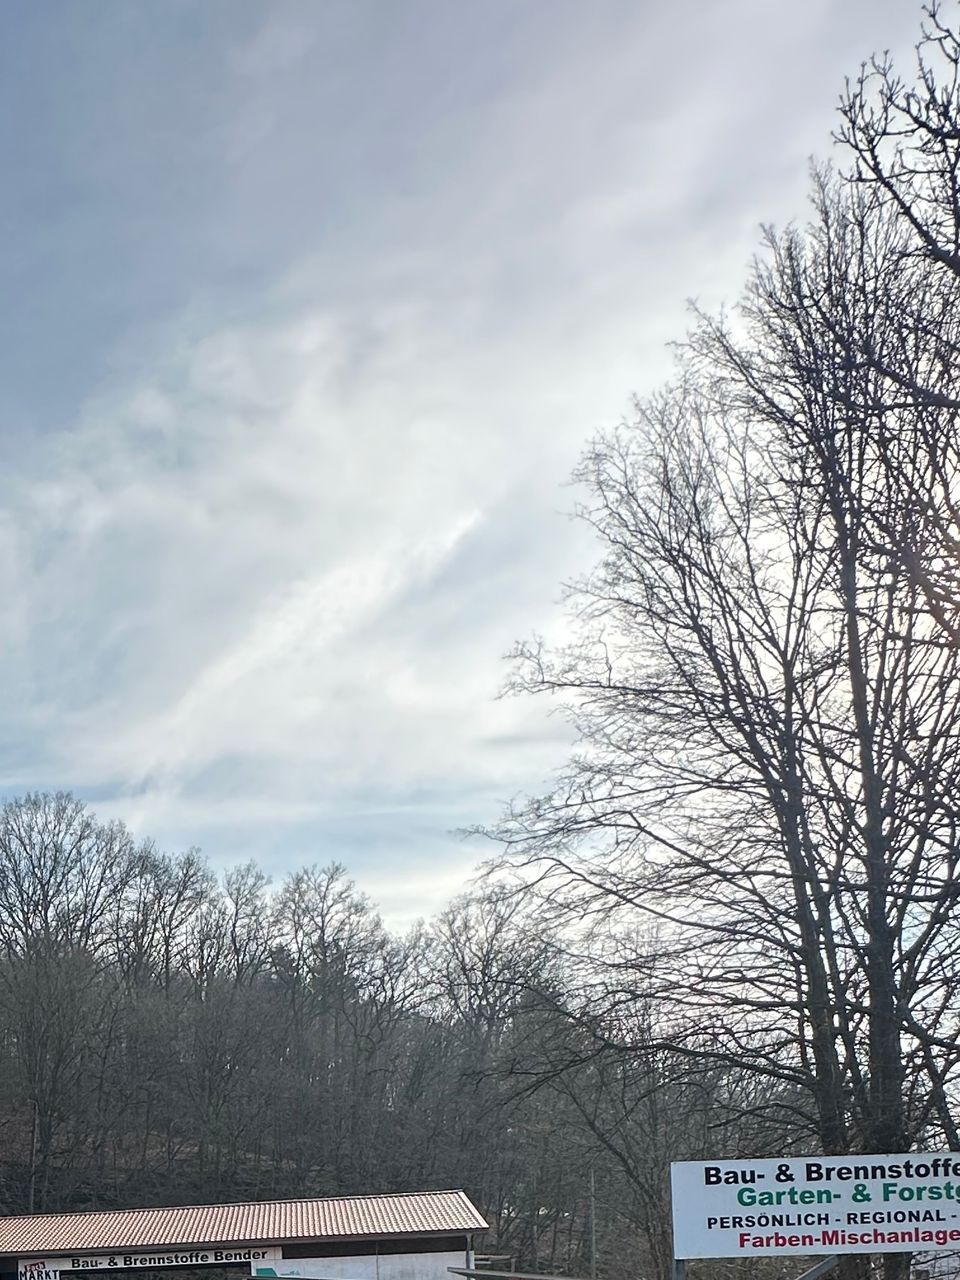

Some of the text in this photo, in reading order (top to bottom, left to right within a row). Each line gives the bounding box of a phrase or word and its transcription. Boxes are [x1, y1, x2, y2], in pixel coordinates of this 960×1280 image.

[704, 1166, 765, 1186] Bau-
[775, 1164, 796, 1182] &
[737, 1187, 841, 1206] Garten-
[852, 1183, 872, 1202] &
[707, 1212, 830, 1229] PERSÖNLICH
[847, 1209, 946, 1225] REGIONAL
[739, 1227, 960, 1248] Farben-Mischanlage
[71, 1250, 268, 1268] Bau- & Brennstoffe Bender
[20, 1269, 58, 1280] MARKT
